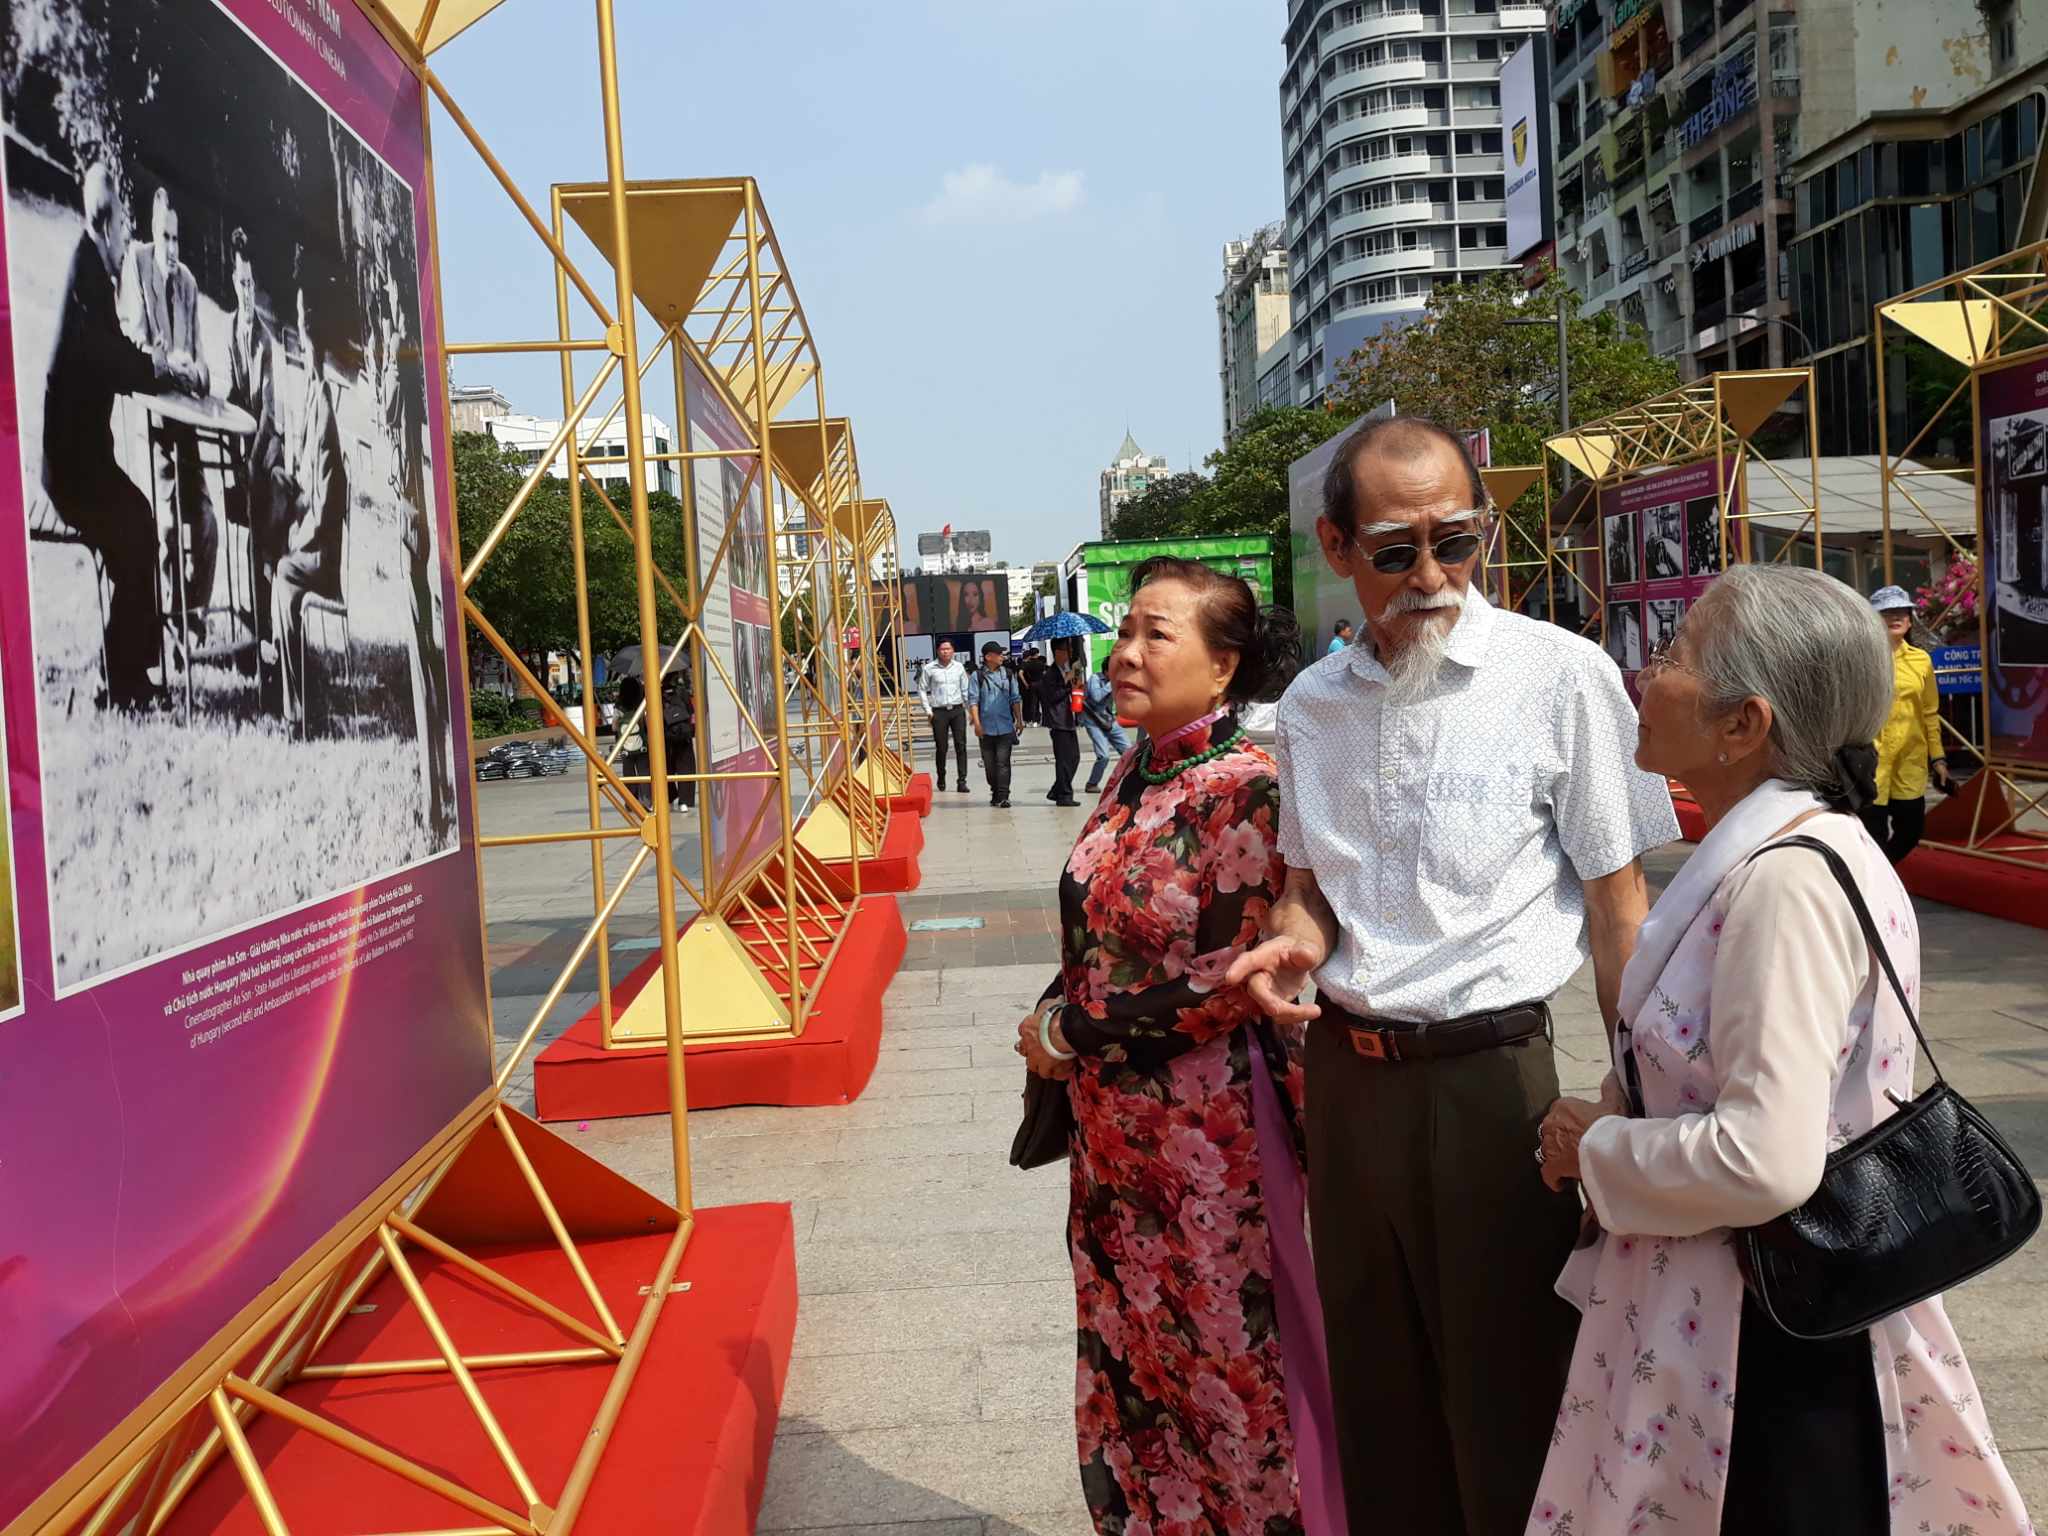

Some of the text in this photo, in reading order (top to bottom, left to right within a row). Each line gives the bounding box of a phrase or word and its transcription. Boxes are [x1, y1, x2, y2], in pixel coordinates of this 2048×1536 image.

[317, 36, 347, 81] CINEMA
[1708, 222, 1757, 263] DOWNTOWN
[1944, 649, 1969, 661] CÔNG
